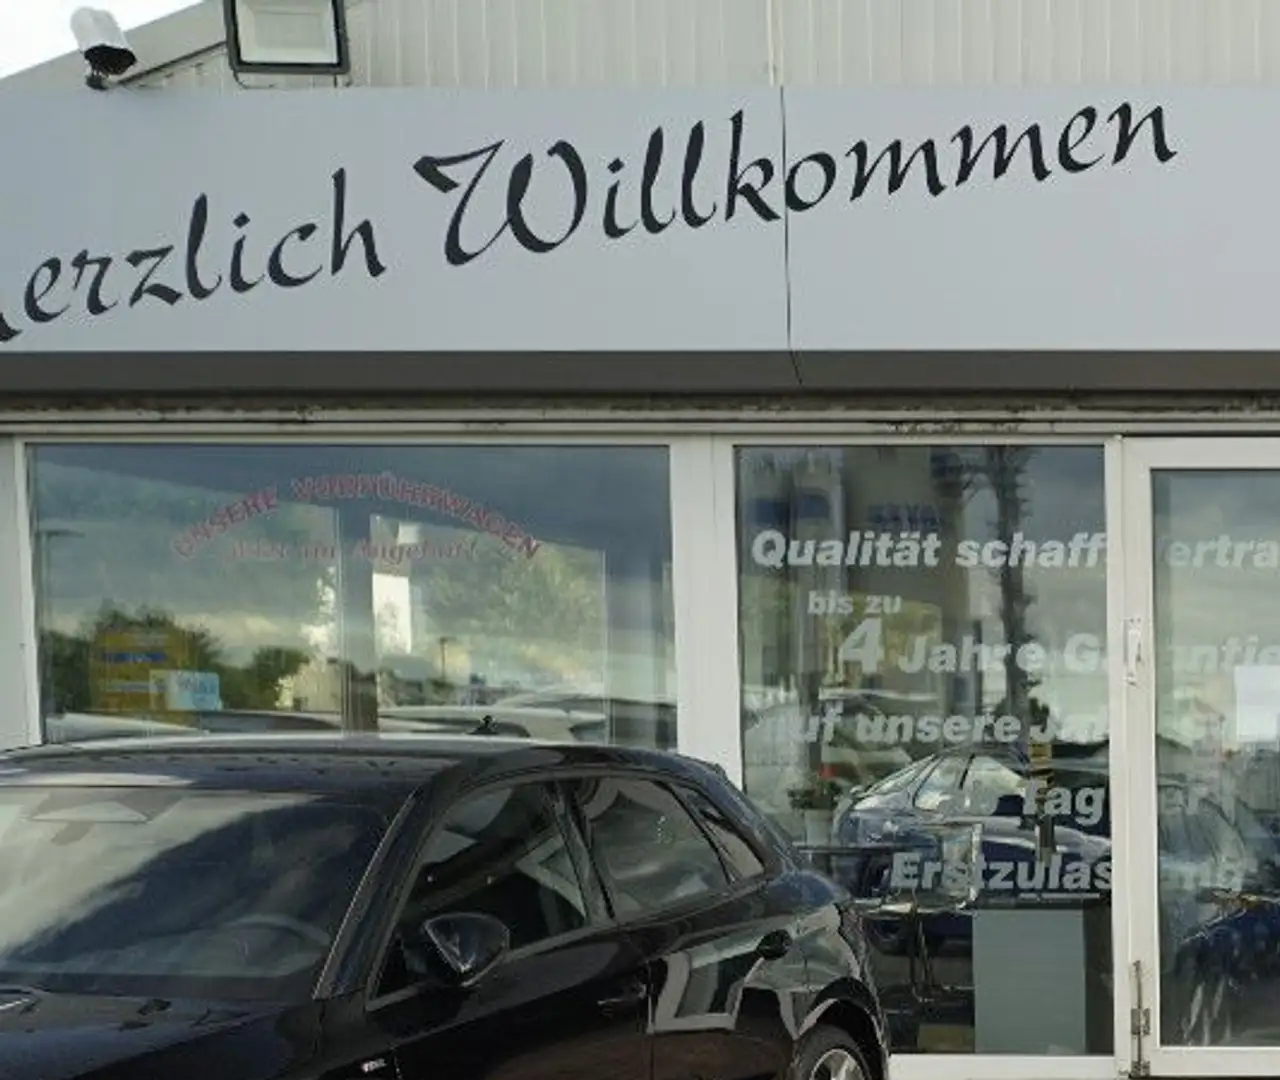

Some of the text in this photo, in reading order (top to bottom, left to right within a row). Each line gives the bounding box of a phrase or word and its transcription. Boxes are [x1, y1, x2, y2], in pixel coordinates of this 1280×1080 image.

[0, 102, 1178, 342] erzlich Willkommen
[751, 530, 942, 568] Qualität
[954, 532, 1107, 568] schaff
[807, 589, 902, 614] bis zu
[837, 616, 884, 674] 4
[896, 634, 1047, 673] Jahre
[855, 711, 1022, 743] unsere
[1022, 778, 1106, 825] Tag
